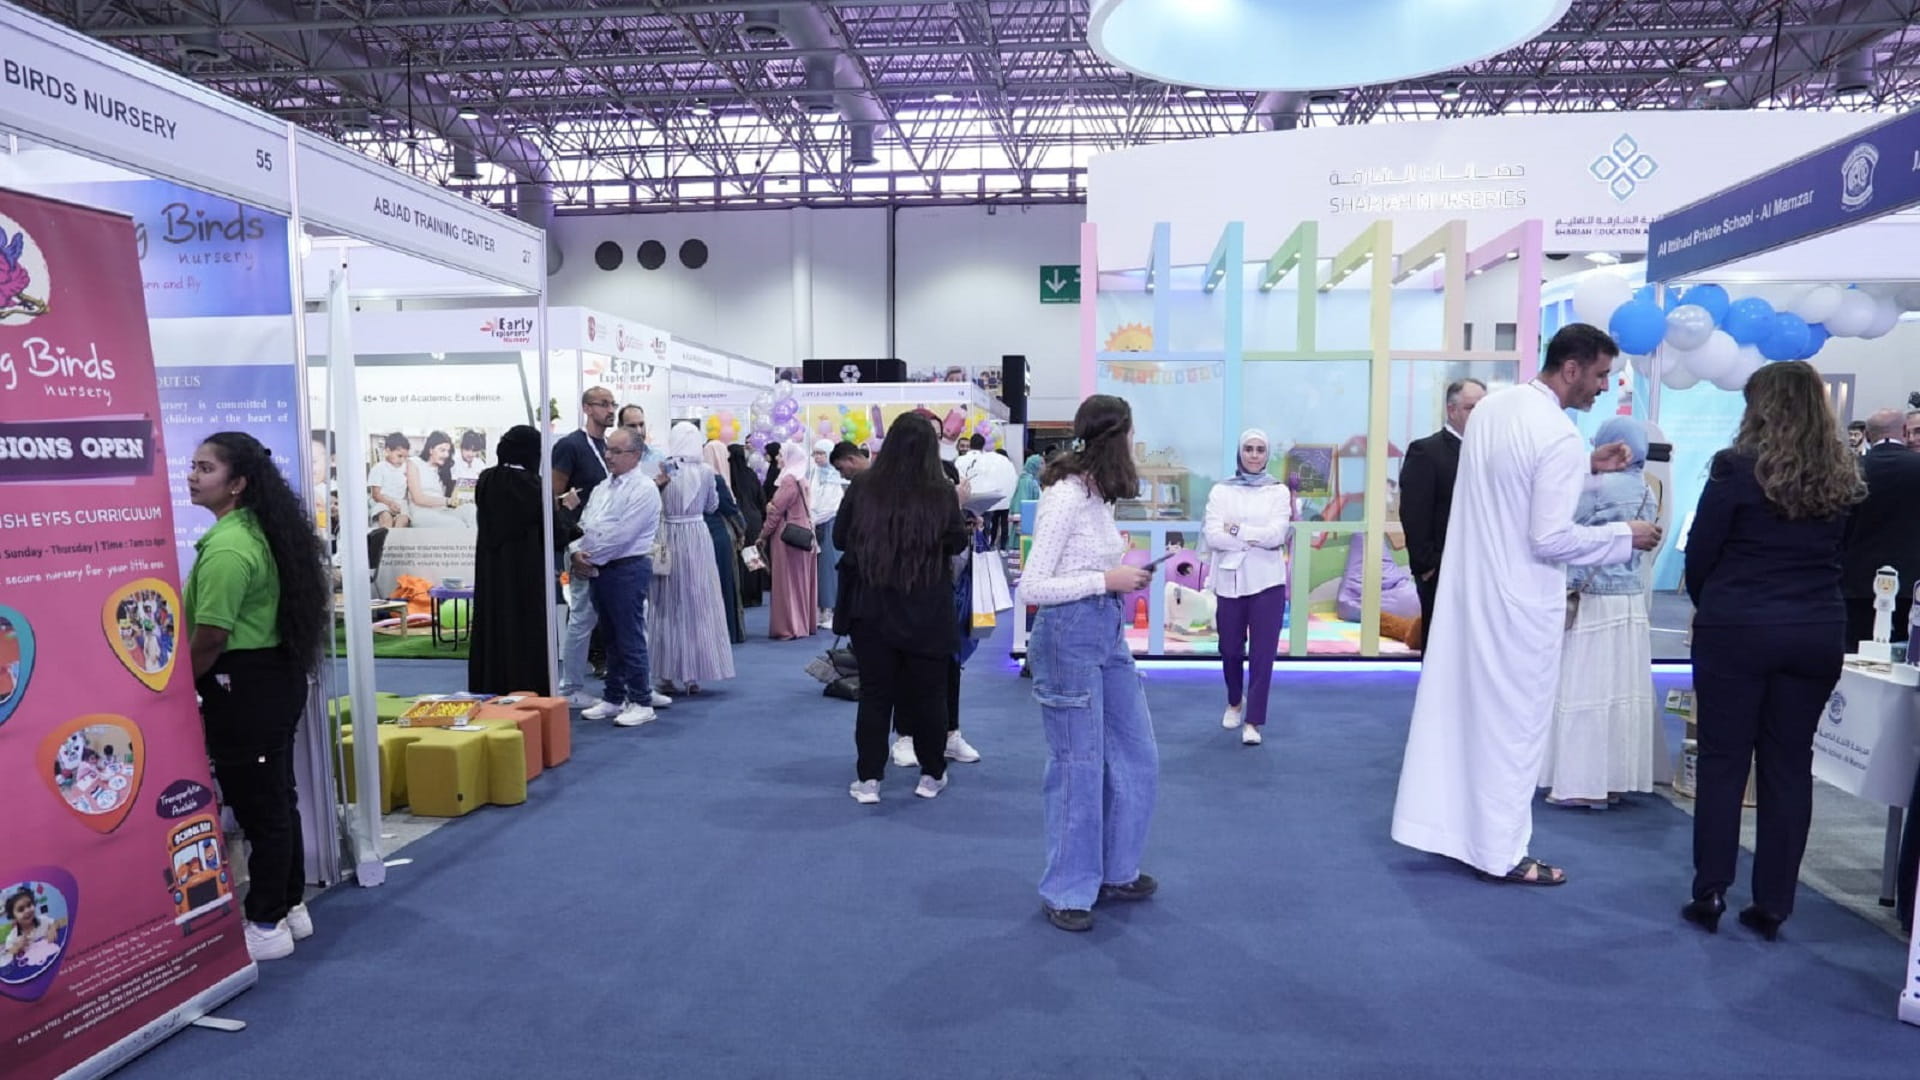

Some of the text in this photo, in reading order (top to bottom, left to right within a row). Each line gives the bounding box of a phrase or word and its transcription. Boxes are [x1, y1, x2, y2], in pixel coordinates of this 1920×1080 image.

[4, 58, 177, 141] BIRDS NURSERY
[255, 149, 273, 172] 55
[160, 202, 264, 244] Birds
[374, 197, 496, 253] ABJAD TRAINING CENTER
[1658, 241, 1667, 258] Al
[1693, 224, 1722, 245] Private
[1723, 209, 1754, 234] School
[1760, 202, 1772, 221] Al
[1773, 190, 1815, 216] Mamzar
[178, 251, 253, 272] nursery
[522, 249, 531, 264] 27
[499, 317, 533, 334] Early
[22, 336, 116, 381] Birds
[44, 384, 112, 407] nursery
[216, 400, 268, 409] committed
[410, 394, 453, 402] Academic
[247, 414, 271, 423] heart
[80, 436, 144, 459] OPEN
[31, 511, 72, 527] EYFS
[75, 506, 162, 524] CURRICULUM
[5, 547, 43, 559] Sunday
[5, 575, 42, 585] secure
[46, 568, 83, 582] nursery
[85, 564, 102, 575] for
